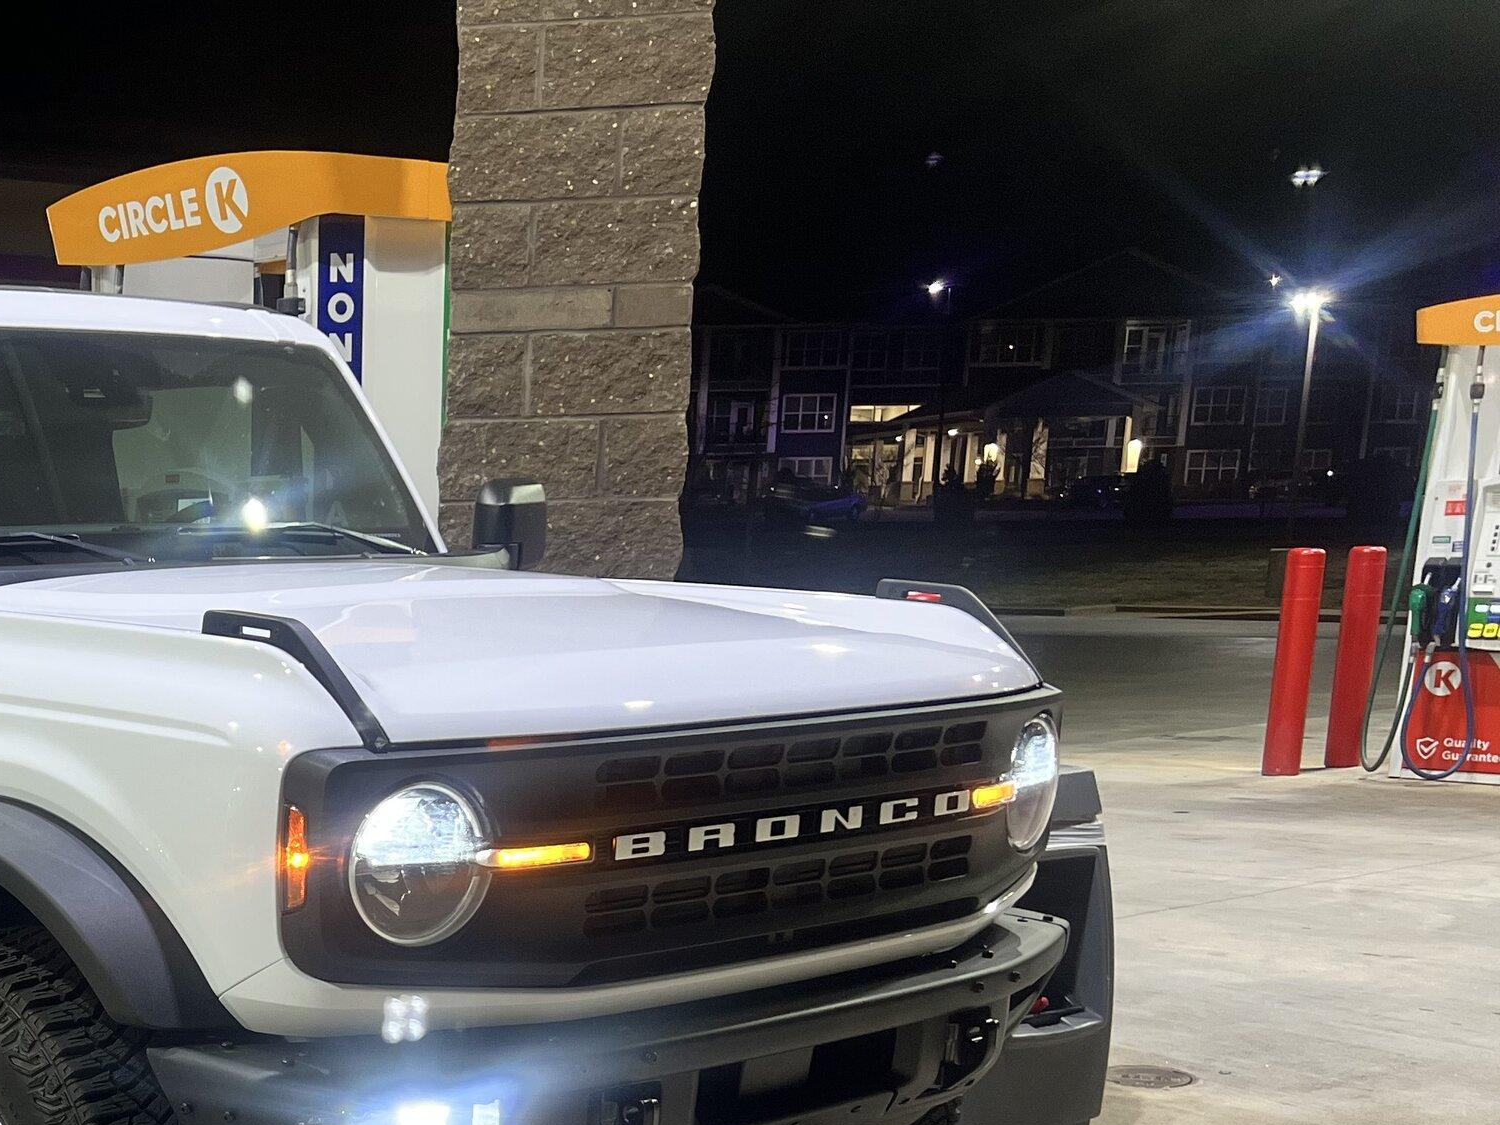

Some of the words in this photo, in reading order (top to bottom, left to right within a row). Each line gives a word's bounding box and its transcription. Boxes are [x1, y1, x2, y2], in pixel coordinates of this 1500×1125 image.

[98, 188, 201, 243] CIRCLE
[212, 175, 249, 233] K
[1430, 666, 1457, 695] K
[1443, 737, 1490, 751] Quaity
[613, 788, 971, 861] BRONCO
